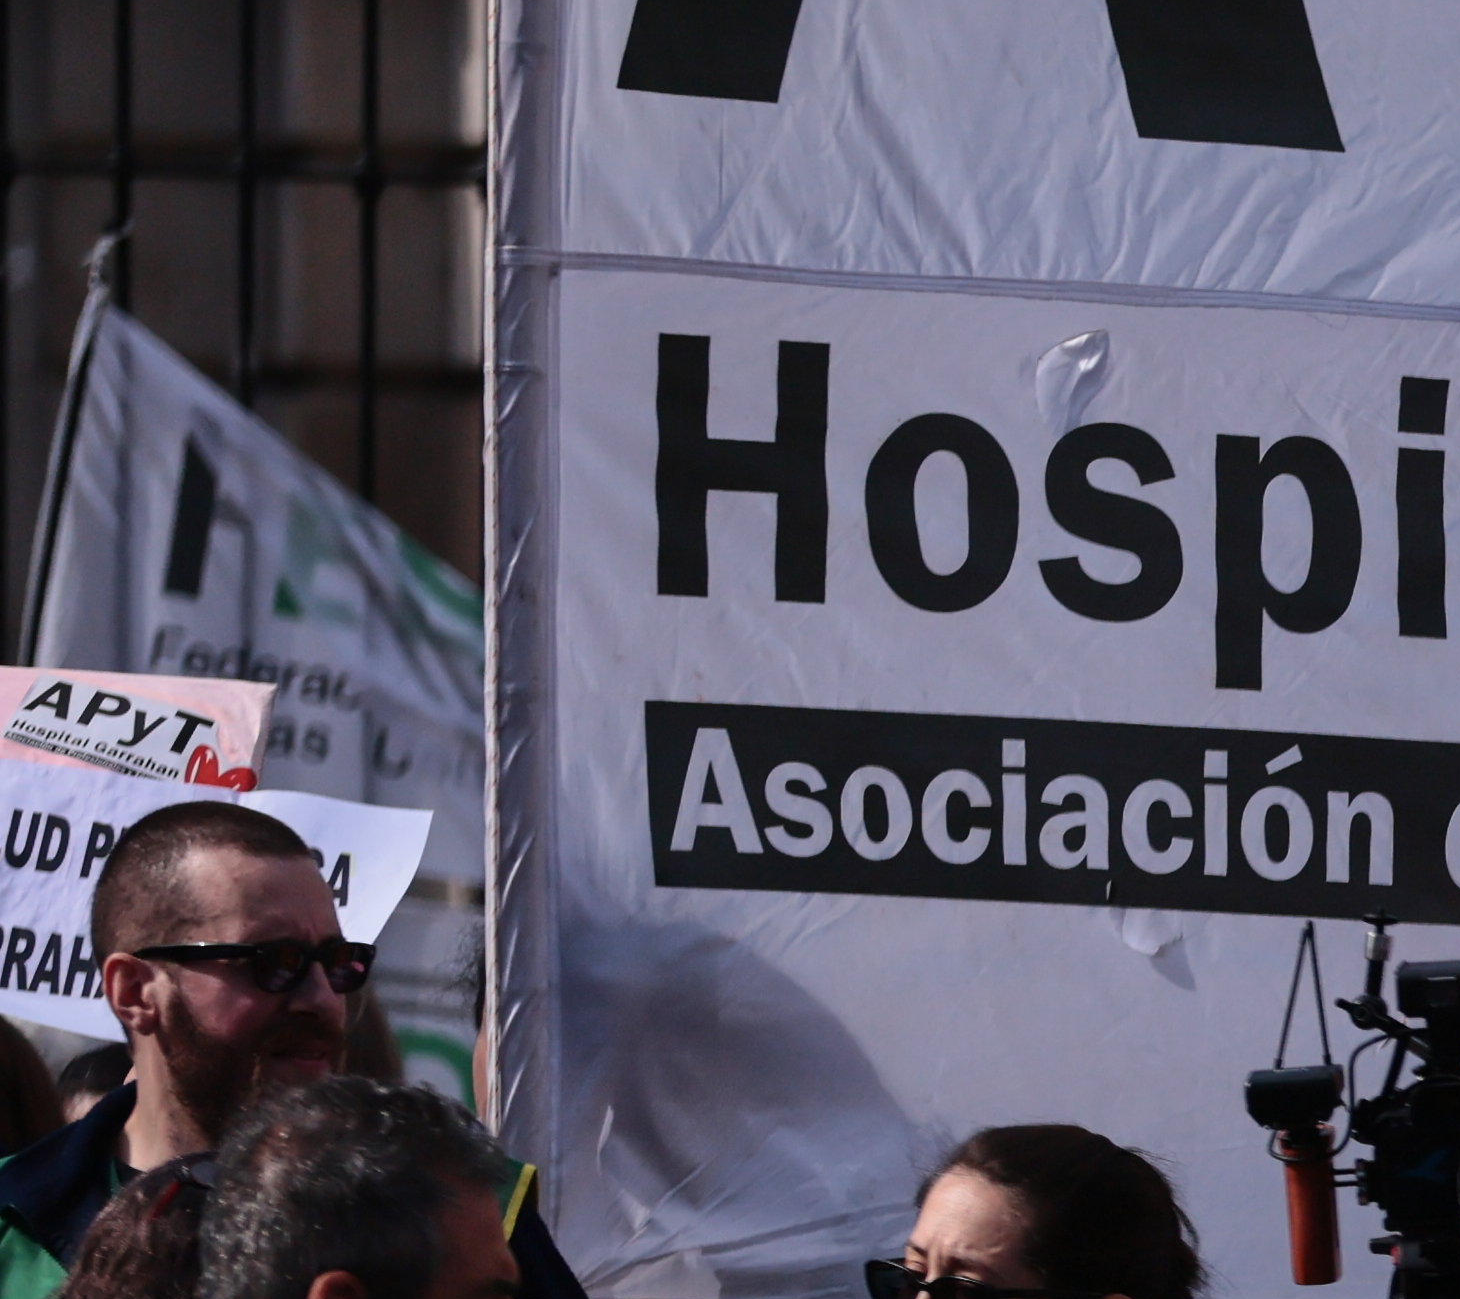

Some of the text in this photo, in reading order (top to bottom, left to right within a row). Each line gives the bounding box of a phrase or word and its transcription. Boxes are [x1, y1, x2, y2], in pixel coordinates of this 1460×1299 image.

[11, 718, 91, 749] Hospital
[93, 740, 180, 780] Garrahan
[22, 680, 214, 755] APyT
[669, 727, 1395, 887] Asociación
